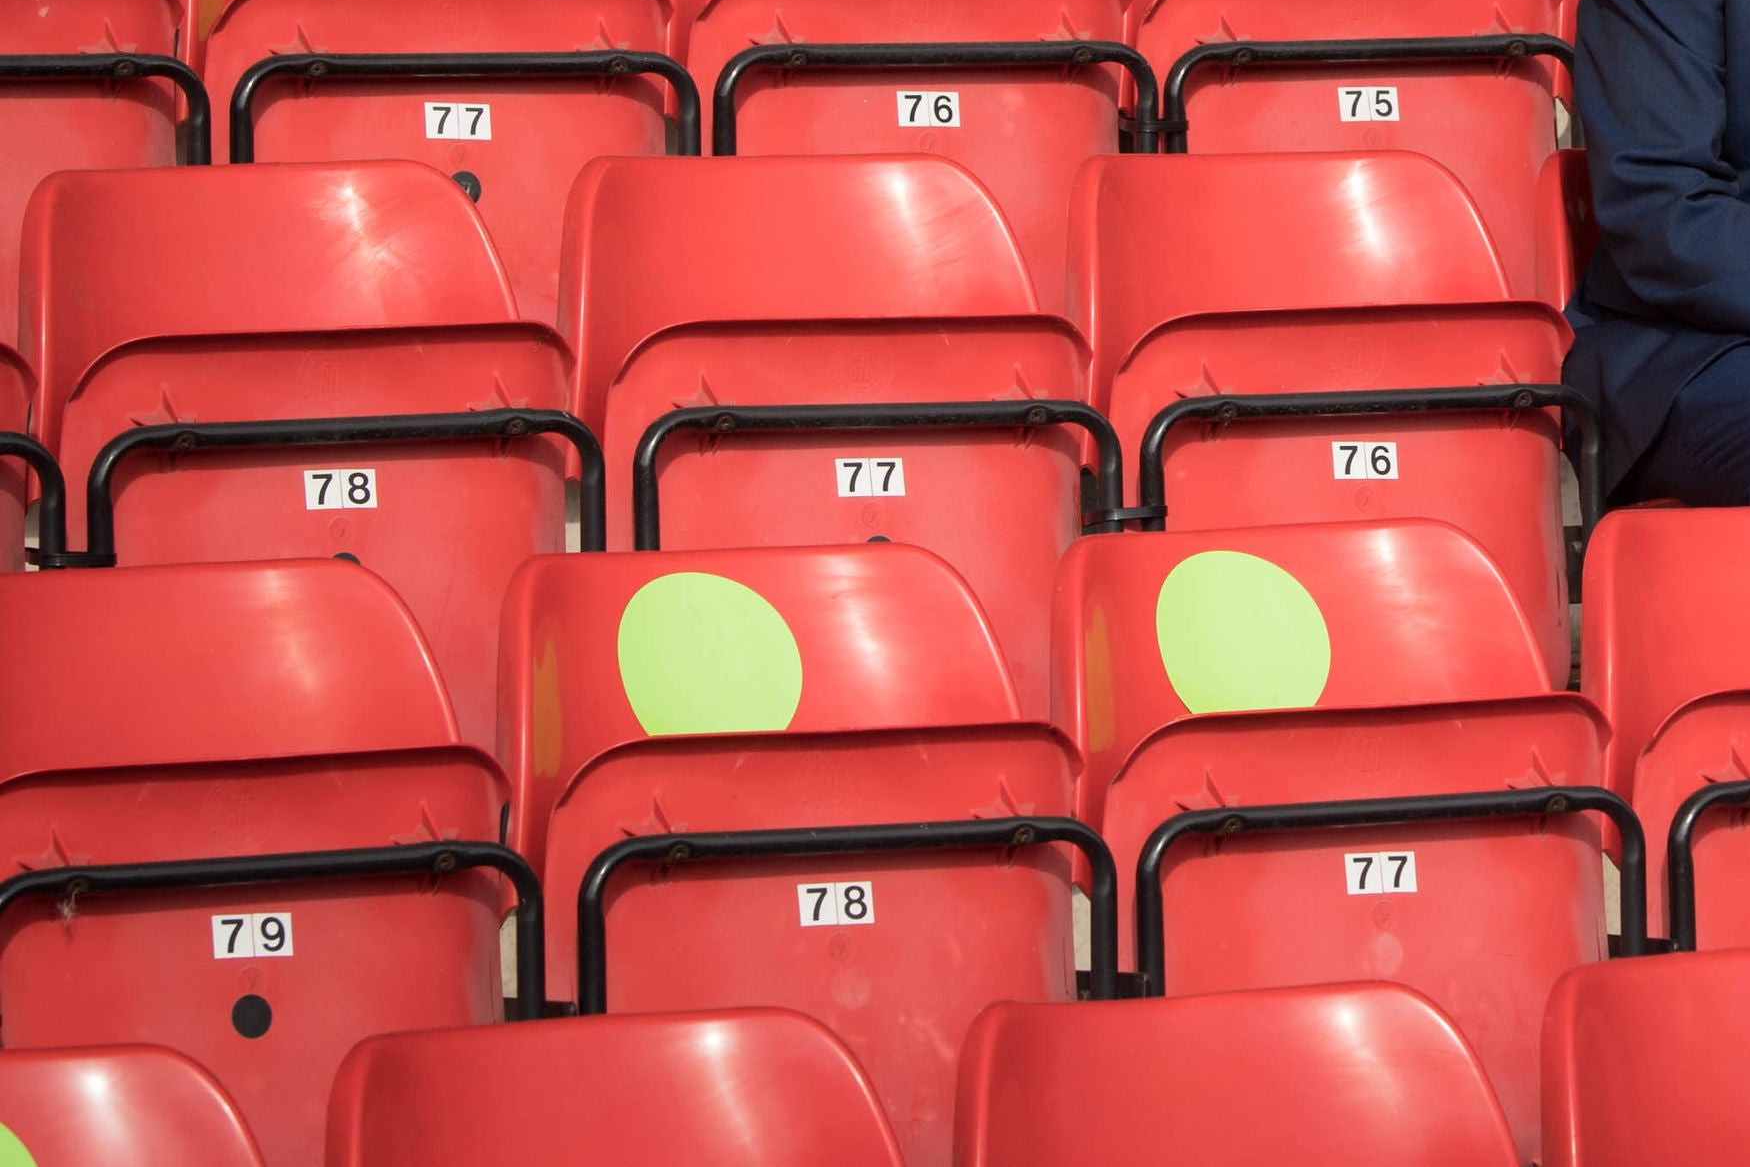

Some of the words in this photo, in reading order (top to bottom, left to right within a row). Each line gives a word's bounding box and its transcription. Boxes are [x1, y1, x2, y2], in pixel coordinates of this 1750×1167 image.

[904, 94, 953, 124] 76
[1345, 90, 1393, 117] 75
[432, 106, 484, 136] 77
[1339, 445, 1391, 476] 76
[311, 472, 371, 505] 78
[843, 461, 896, 493] 77
[1352, 855, 1408, 890] 77
[806, 885, 868, 922] 78
[221, 916, 286, 954] 79
